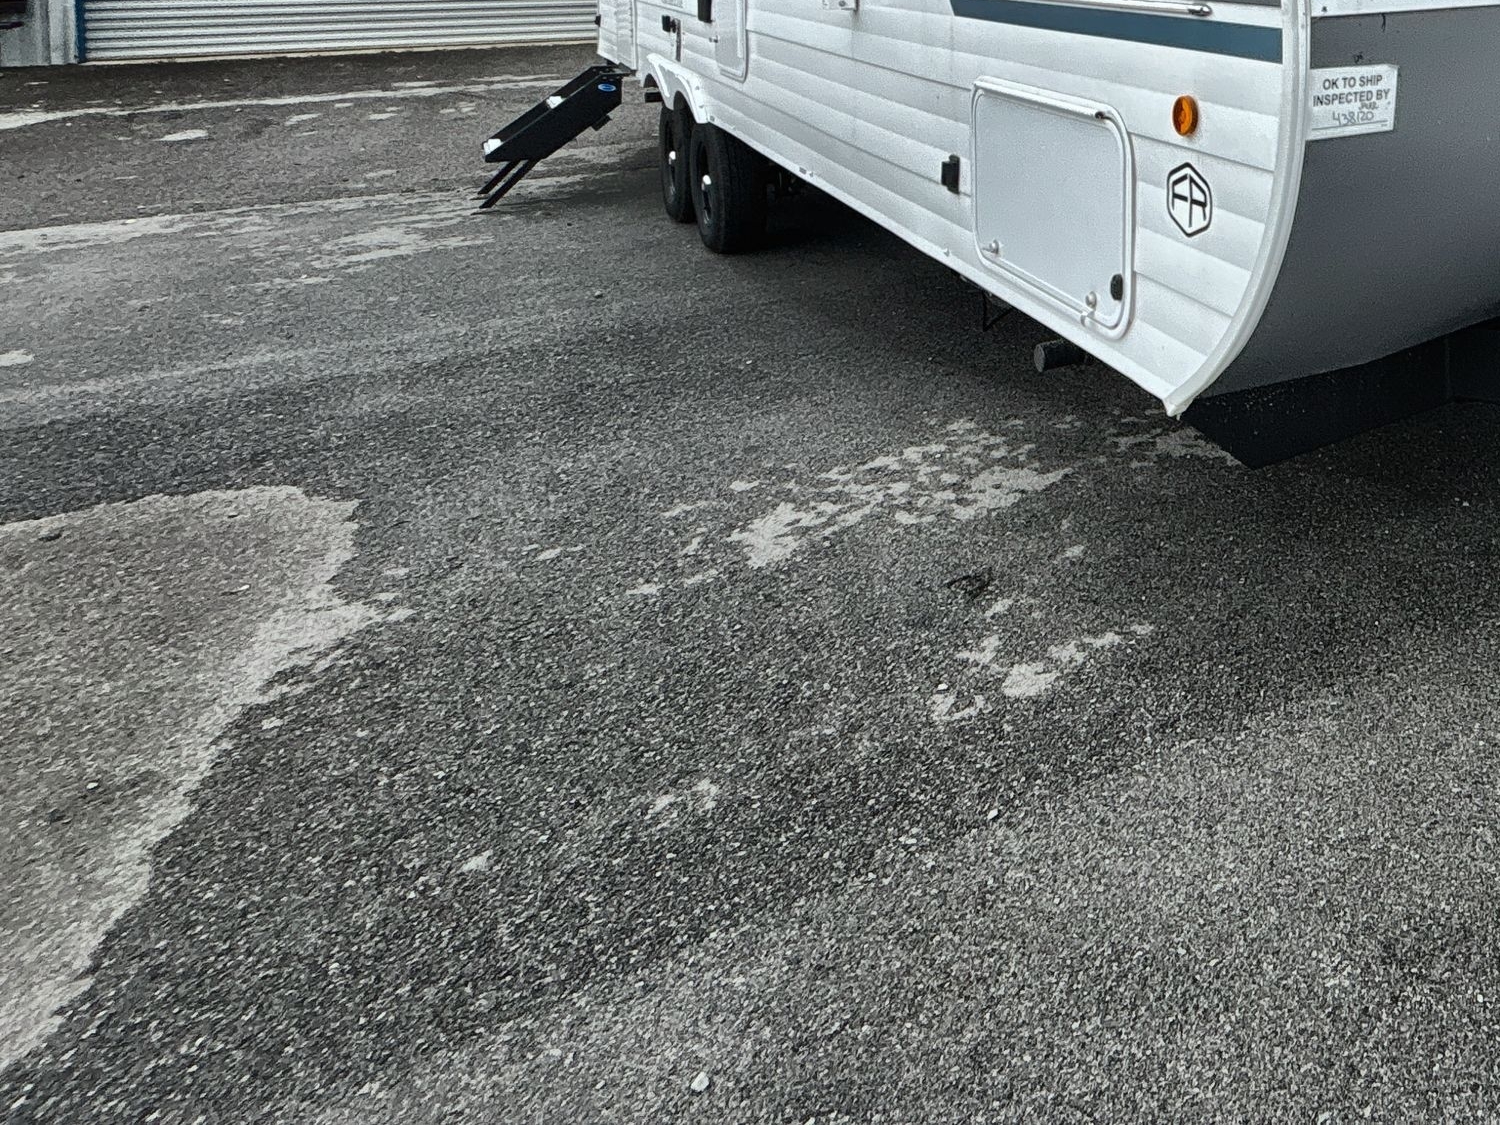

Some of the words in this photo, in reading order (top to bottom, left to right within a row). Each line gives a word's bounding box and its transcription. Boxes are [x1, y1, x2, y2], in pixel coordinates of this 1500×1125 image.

[1322, 77, 1339, 90] OK
[1342, 76, 1356, 88] TO
[1359, 75, 1383, 87] SHIP
[1312, 90, 1374, 107] INSPECTED
[1376, 88, 1391, 101] BY
